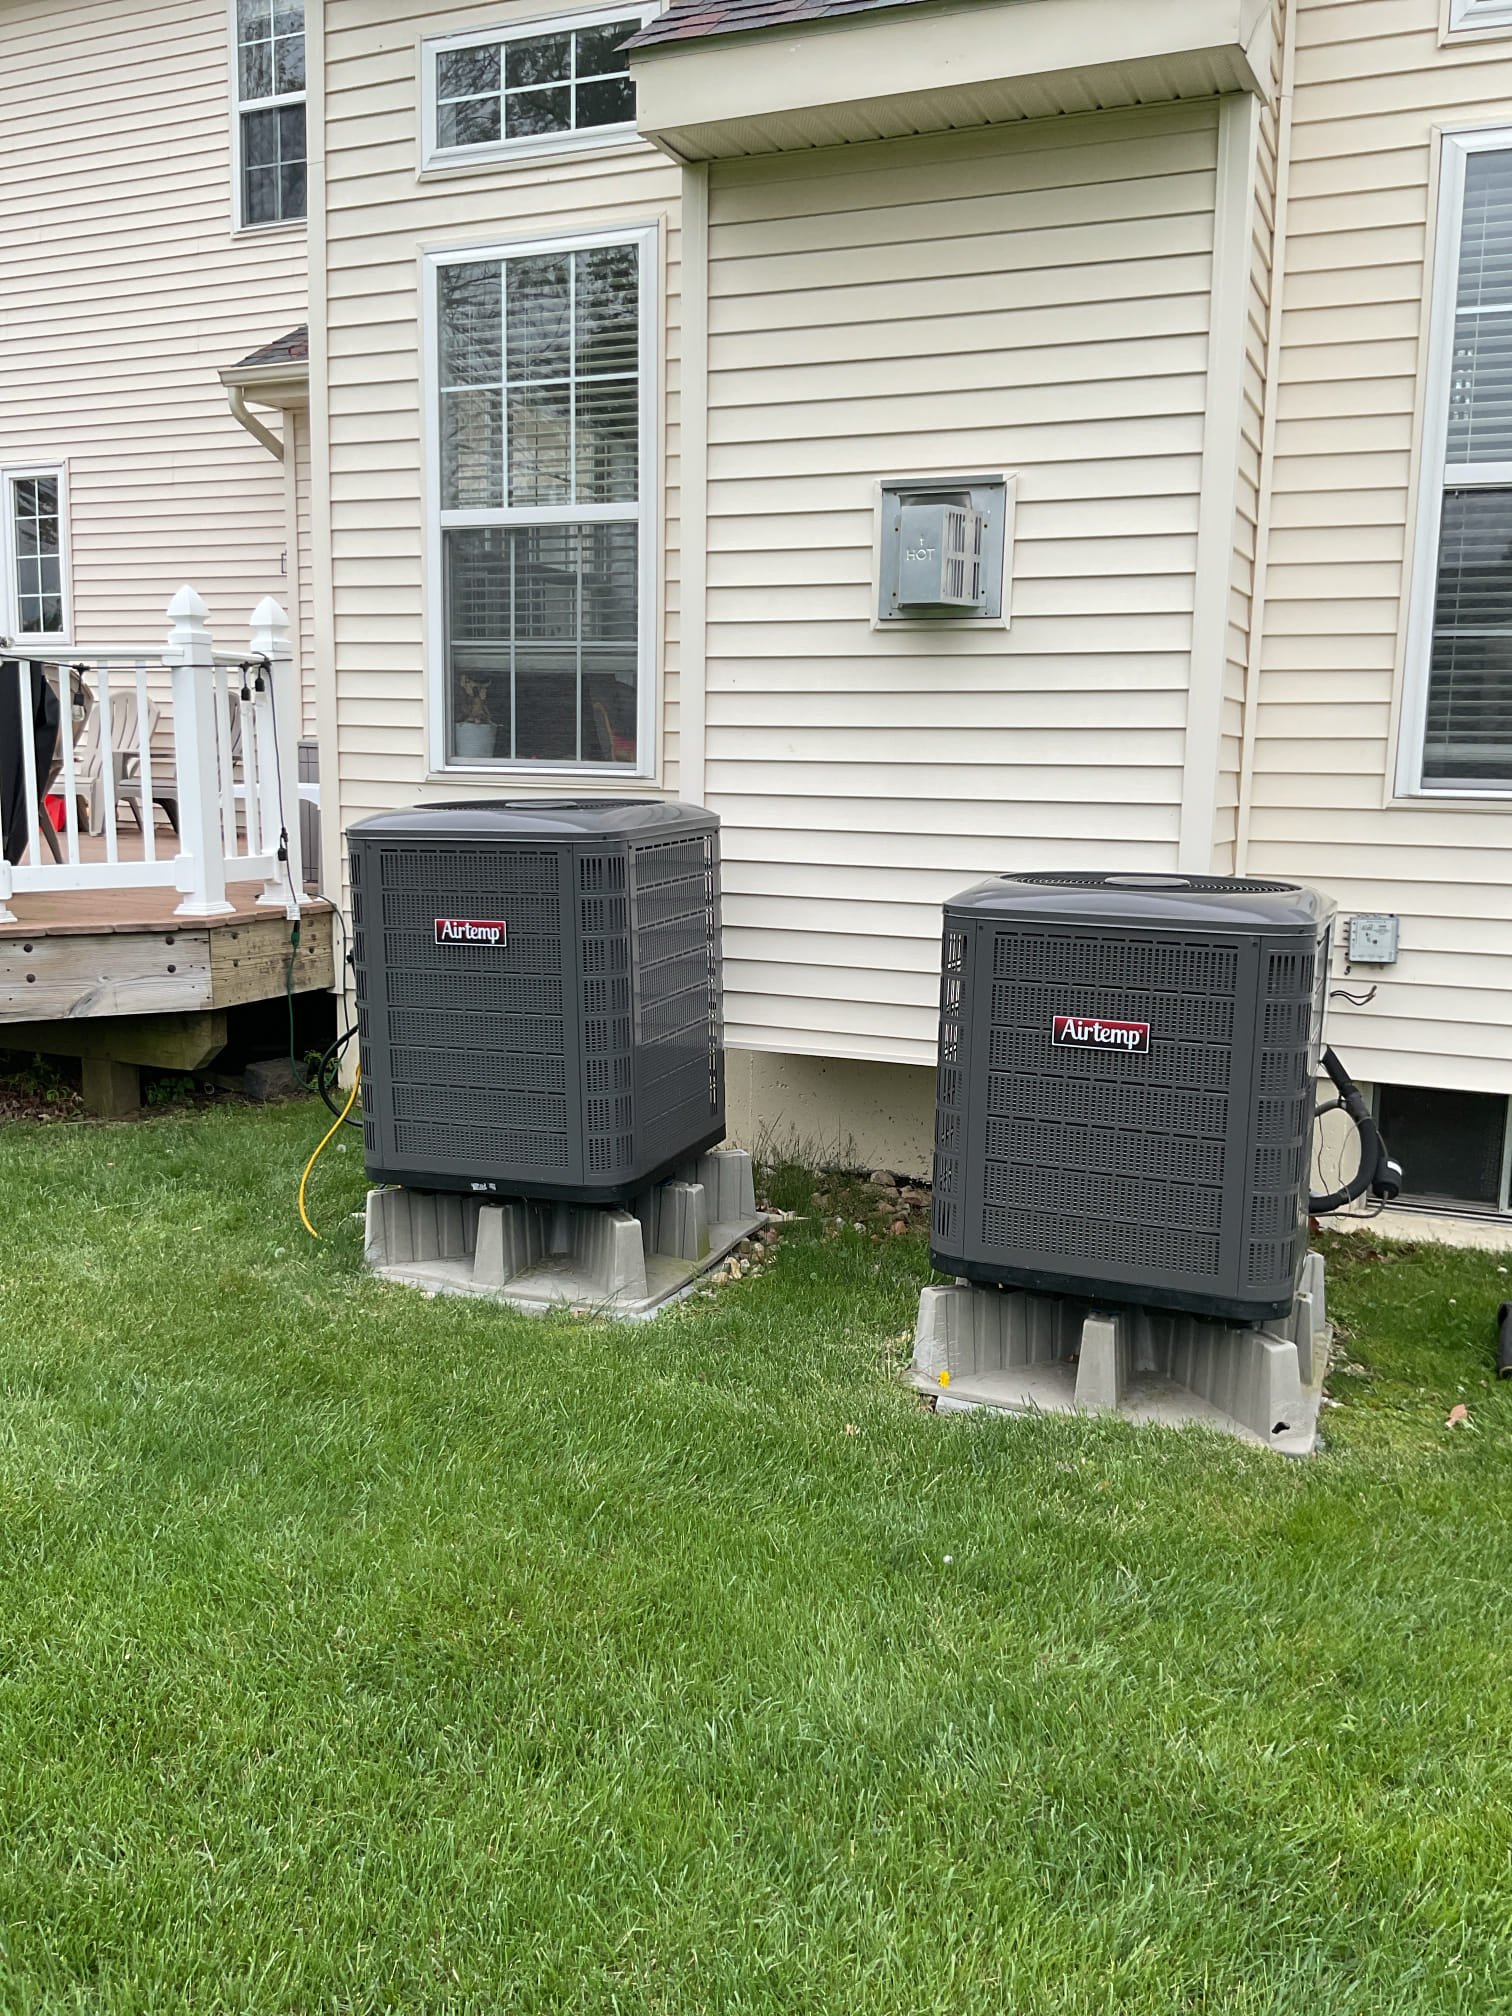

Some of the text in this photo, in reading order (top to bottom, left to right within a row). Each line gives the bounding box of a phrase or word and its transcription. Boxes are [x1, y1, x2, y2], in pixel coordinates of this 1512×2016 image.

[906, 548, 936, 561] HOT
[441, 920, 500, 945] Airtemp
[1060, 1018, 1141, 1050] Airtemp
